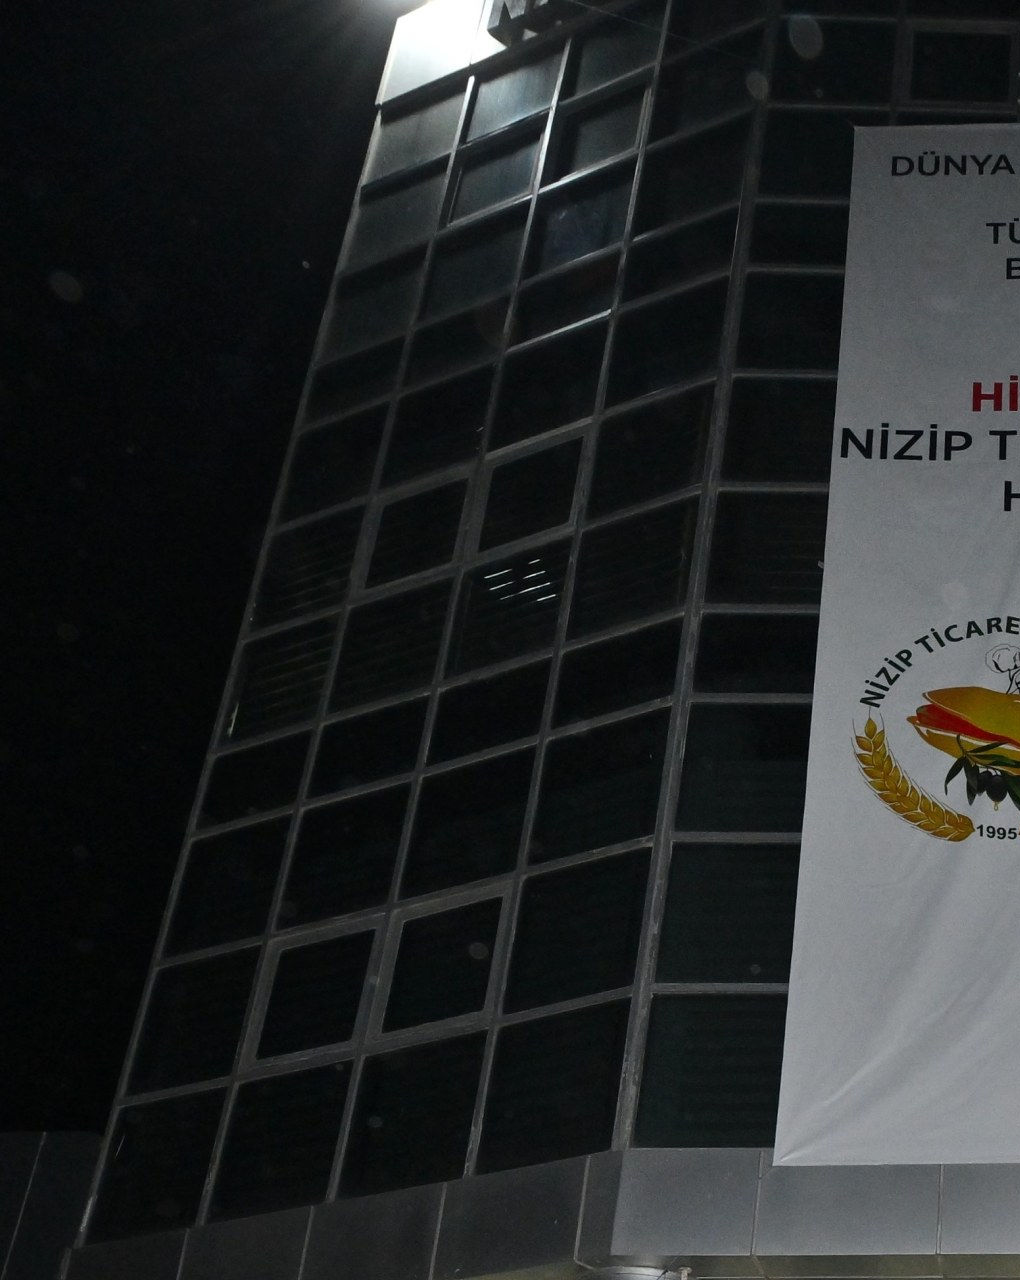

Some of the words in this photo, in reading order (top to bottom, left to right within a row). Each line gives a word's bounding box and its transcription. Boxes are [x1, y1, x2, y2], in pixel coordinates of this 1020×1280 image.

[892, 151, 1015, 177] DÜNYA
[840, 422, 973, 461] NİZİP
[859, 648, 913, 708] NİZİP
[976, 824, 1018, 840] 1995
